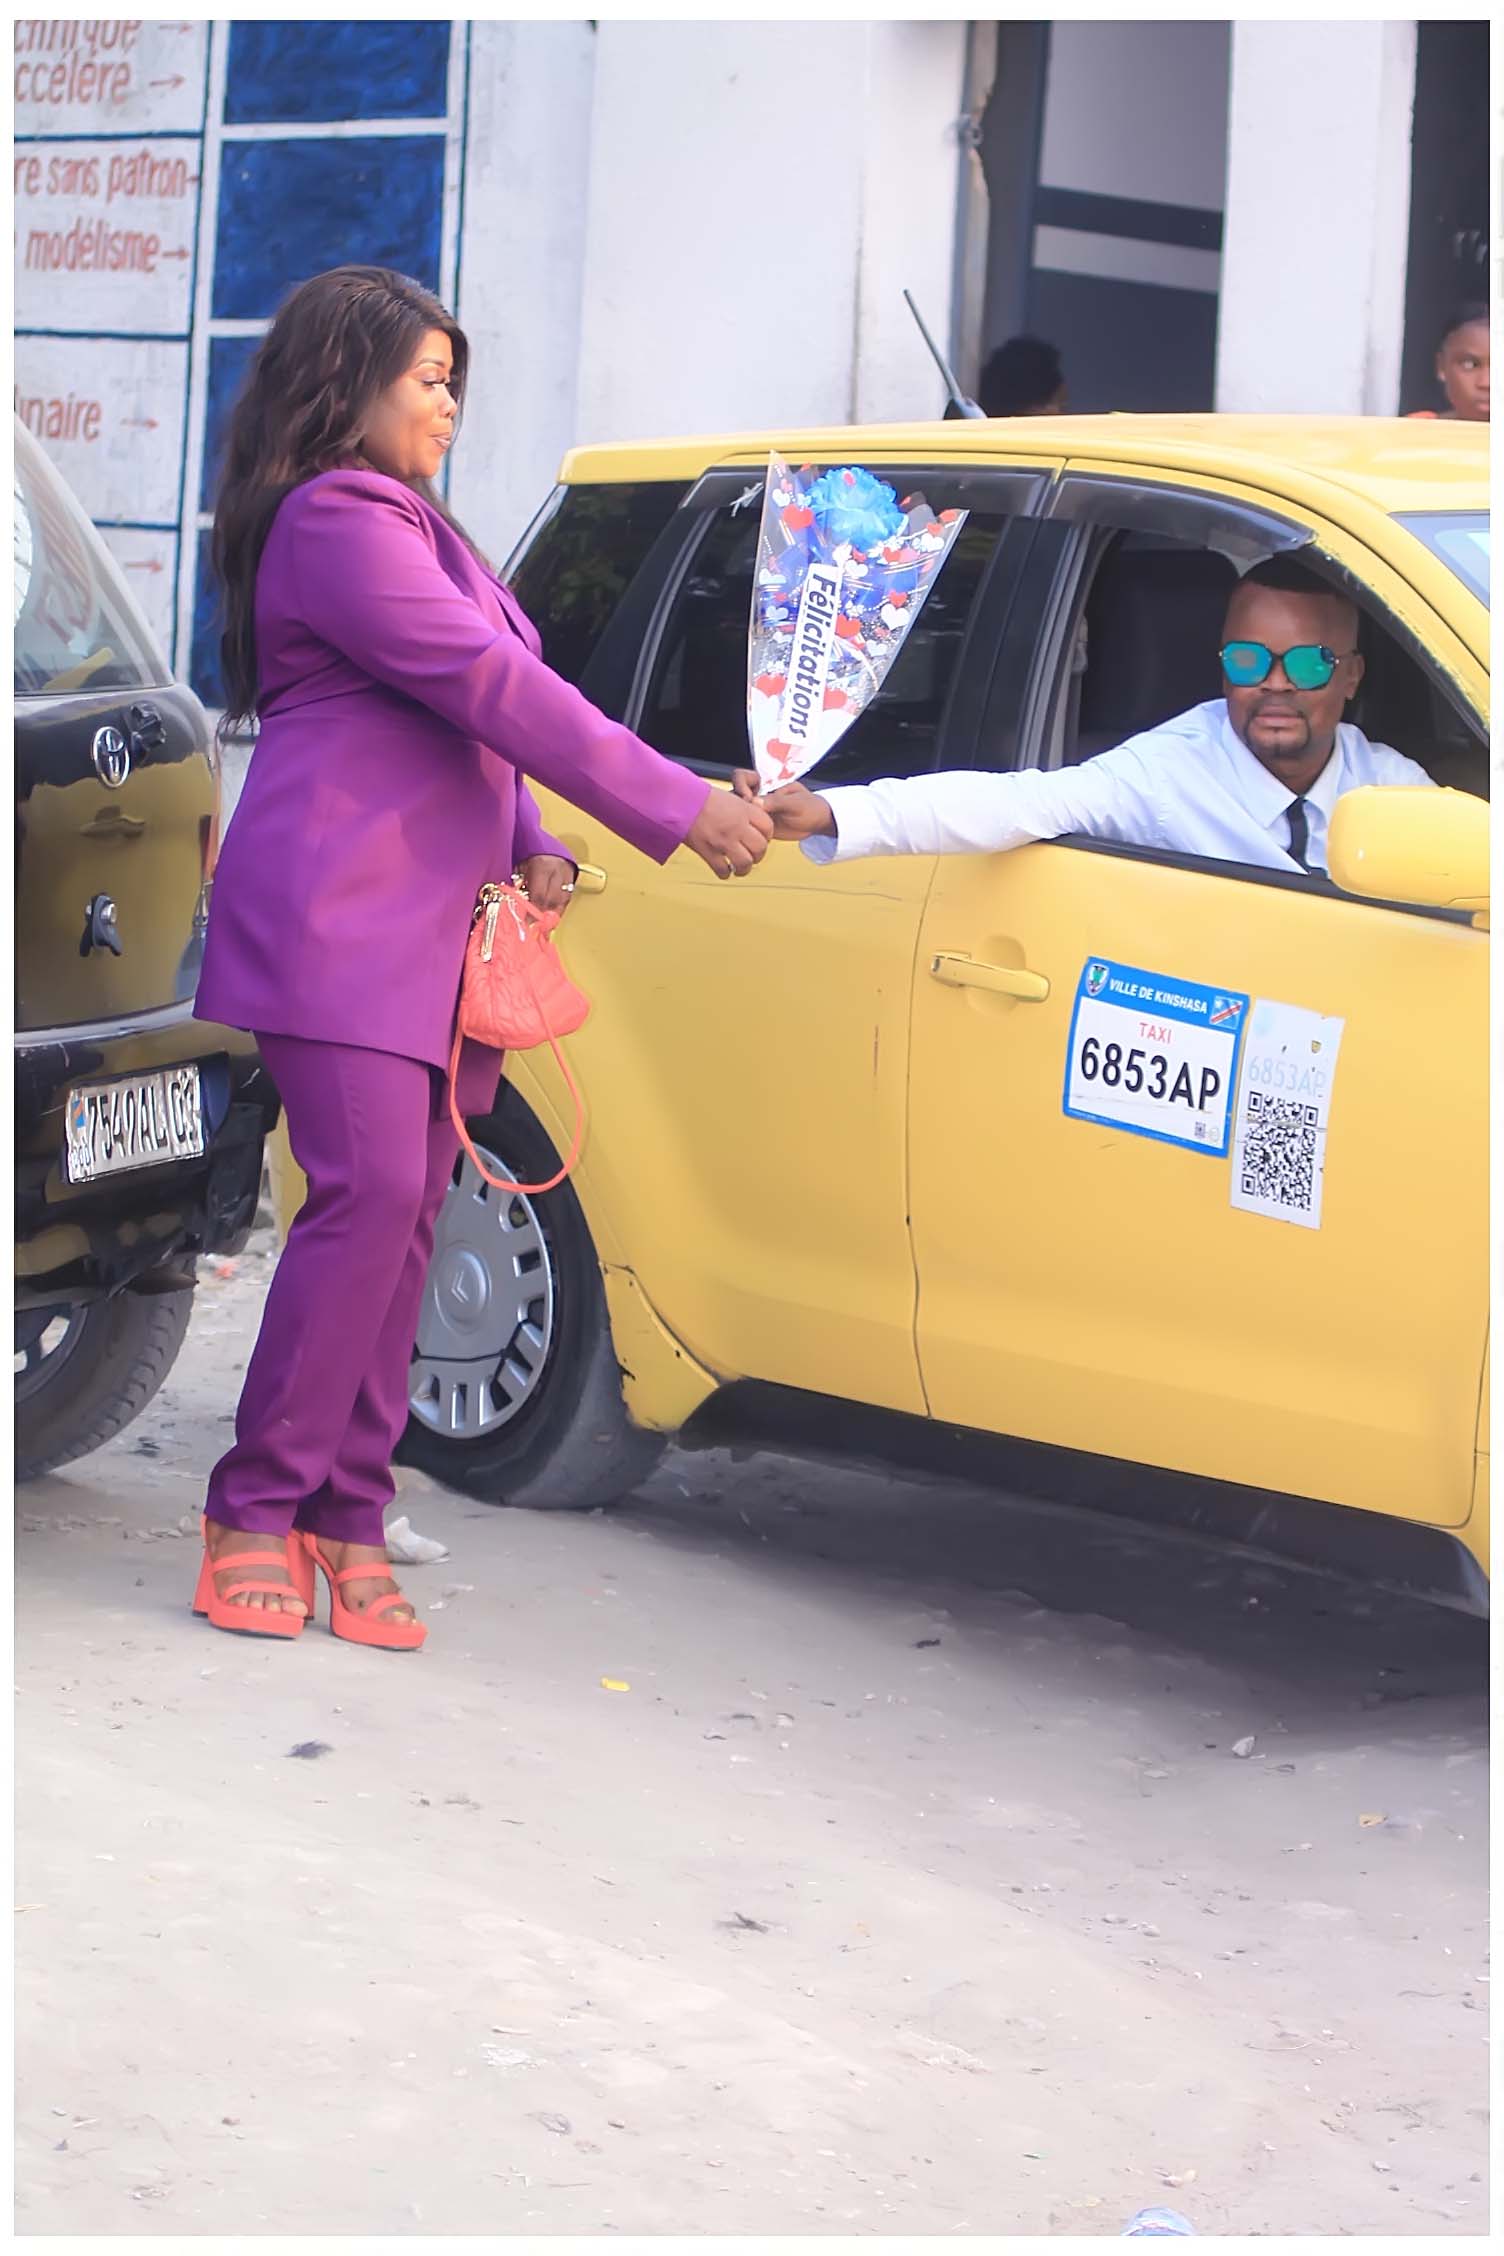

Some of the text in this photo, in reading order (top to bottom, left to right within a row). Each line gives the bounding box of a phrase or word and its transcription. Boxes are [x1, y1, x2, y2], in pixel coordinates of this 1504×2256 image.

[47, 156, 100, 197] sans
[106, 149, 188, 204] patron
[25, 215, 161, 272] modélisme
[789, 573, 837, 739] Félicitations
[1109, 978, 1208, 1015] VILLE DE KINSHASA
[1139, 1022, 1172, 1045] TAXI
[1081, 1037, 1221, 1111] 6853AP
[1249, 1055, 1327, 1098] 6853AP
